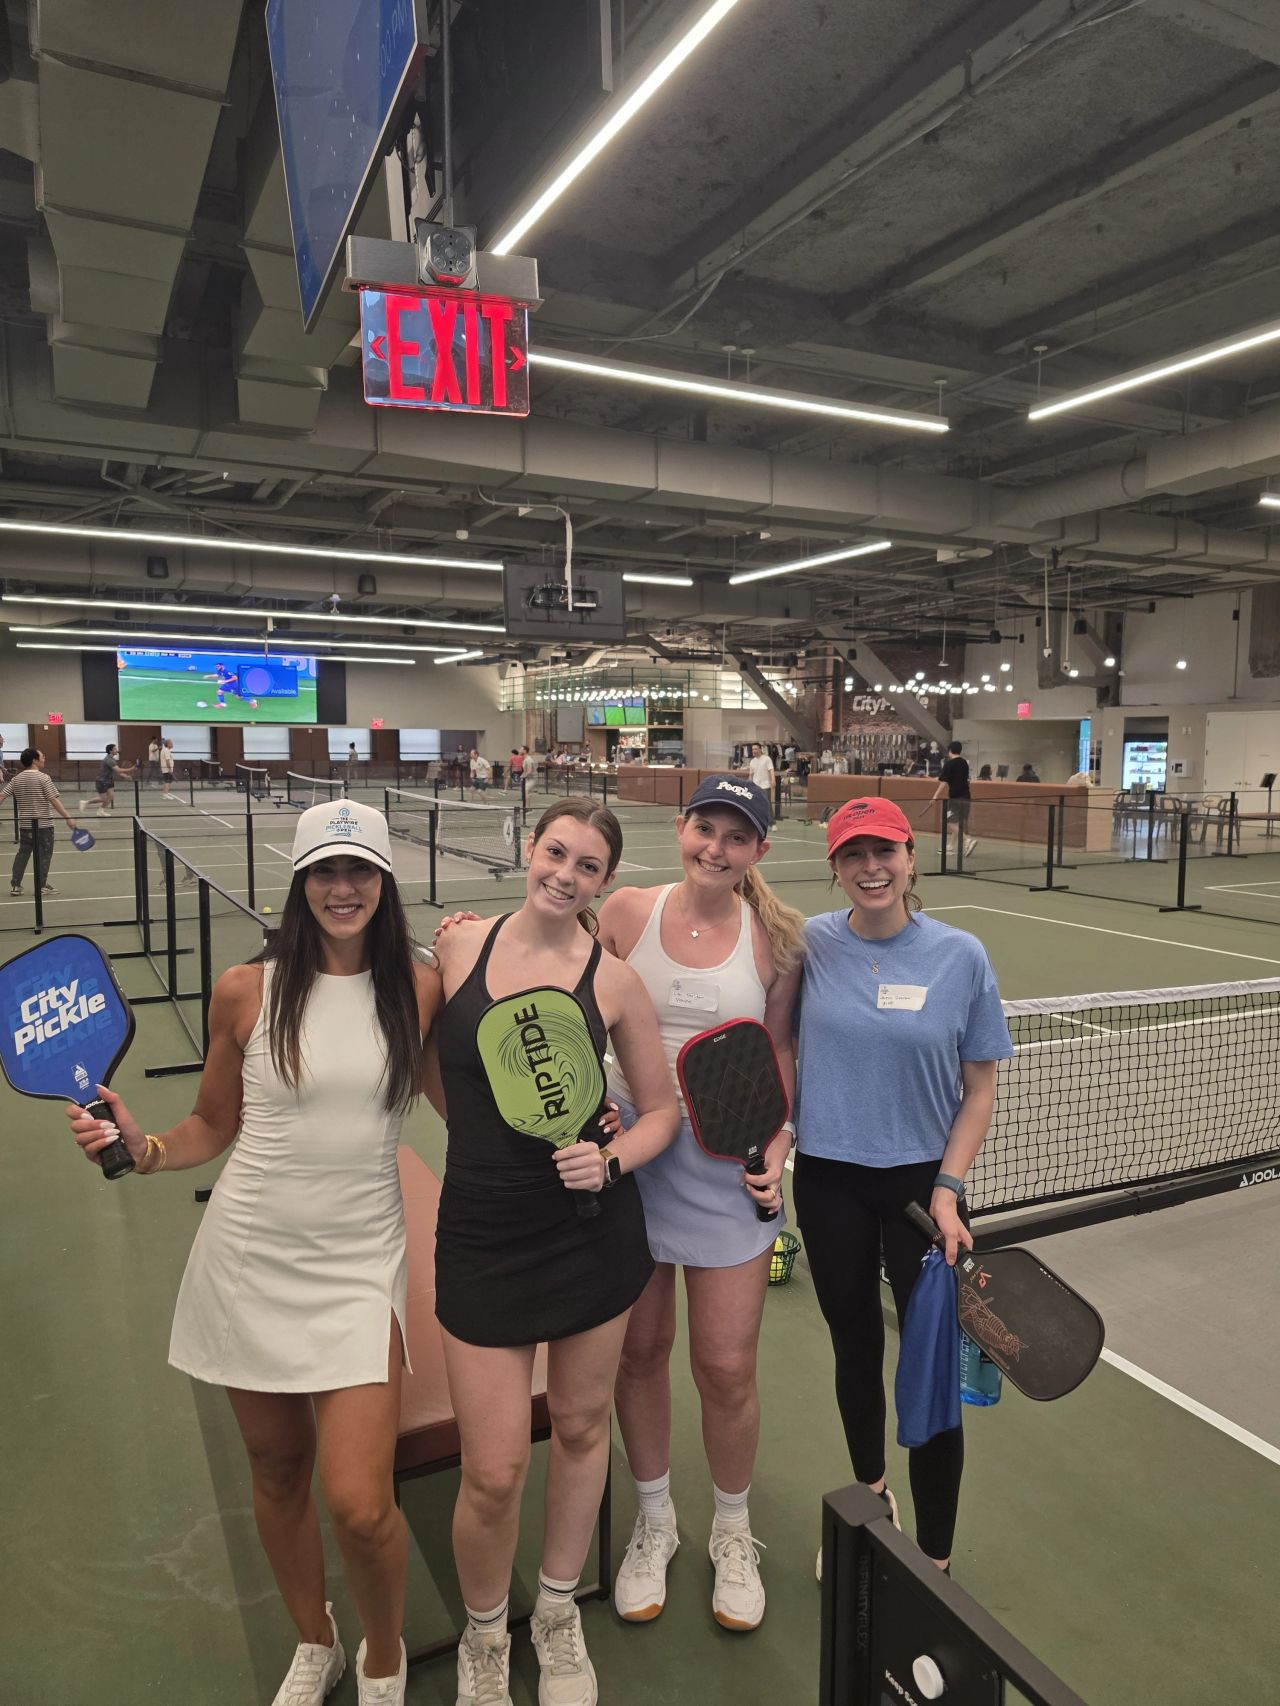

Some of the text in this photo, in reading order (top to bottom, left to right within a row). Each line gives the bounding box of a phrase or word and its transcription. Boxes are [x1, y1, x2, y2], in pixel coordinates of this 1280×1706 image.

[385, 295, 513, 407] EXIT
[716, 781, 754, 800] People
[325, 824, 363, 832] PICKLEBALL
[21, 979, 79, 1024] City
[15, 993, 106, 1056] Pickle
[1249, 1167, 1280, 1185] JOOL
[885, 1668, 904, 1695] Keep
